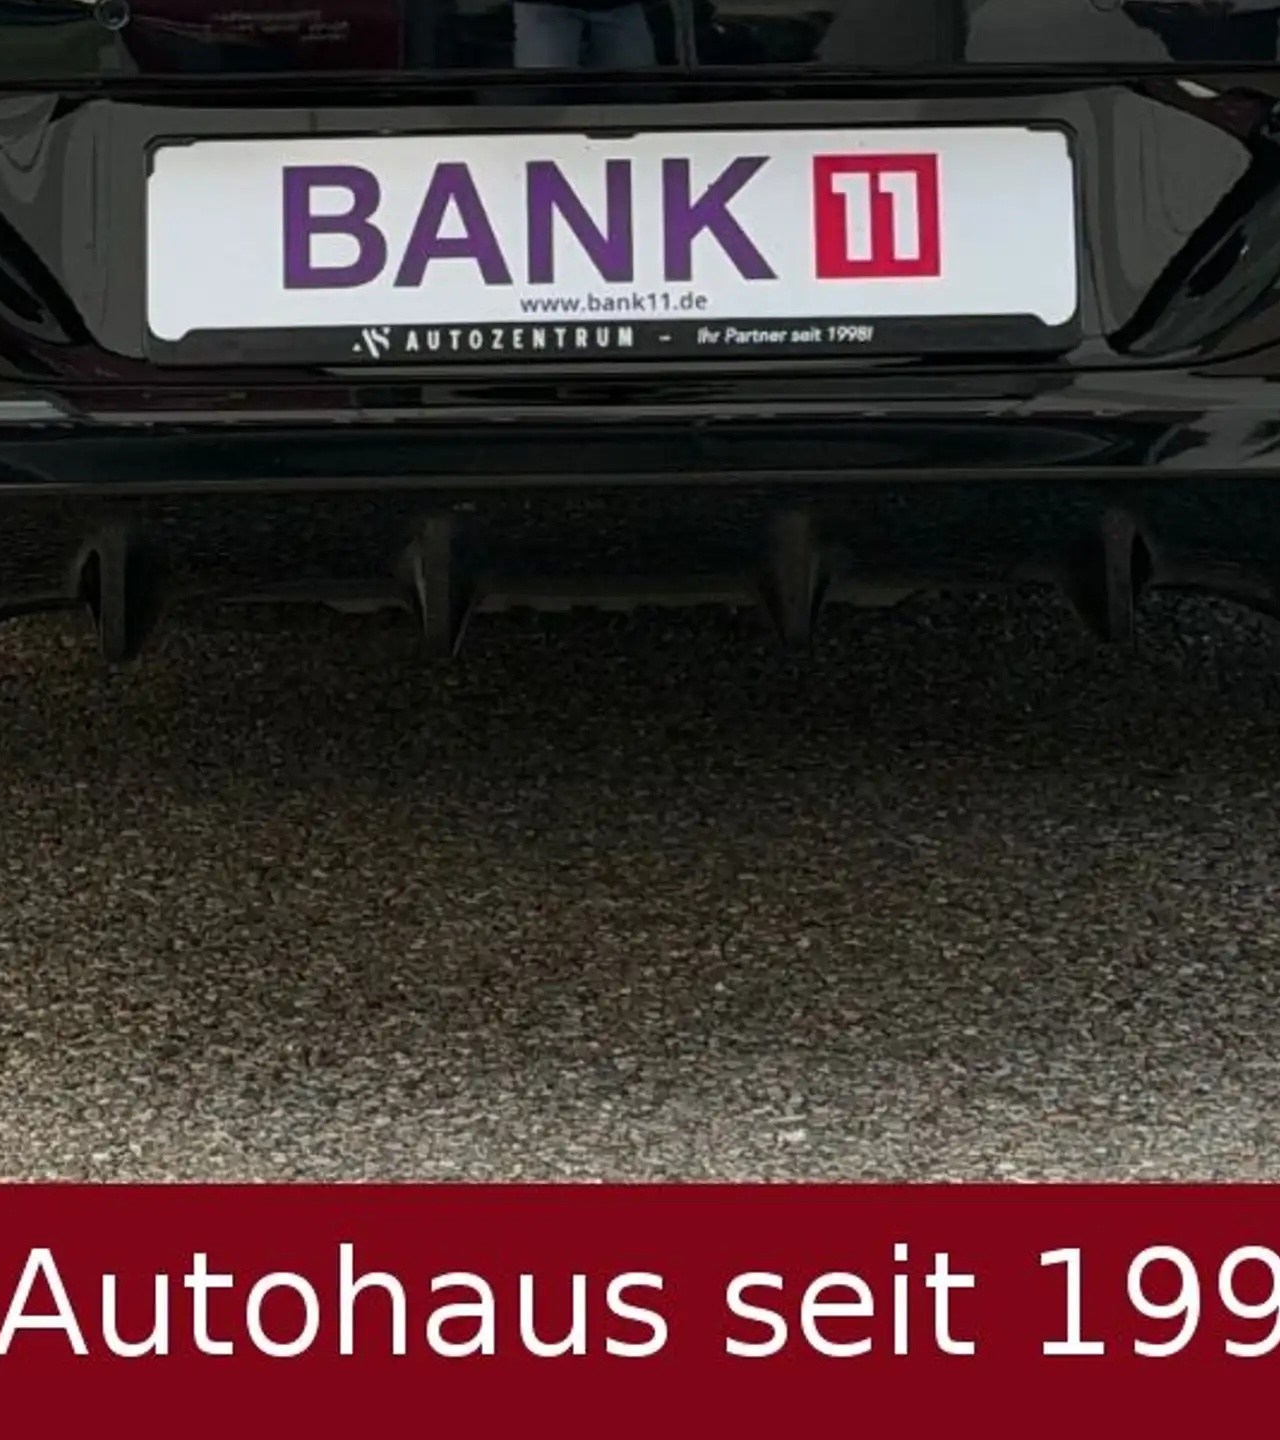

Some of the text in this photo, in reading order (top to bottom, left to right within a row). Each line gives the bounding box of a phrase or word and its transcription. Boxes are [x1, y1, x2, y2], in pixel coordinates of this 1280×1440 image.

[280, 154, 920, 291] BANK 11
[520, 292, 709, 315] www.bank11.de
[405, 326, 634, 351] AUTOZENTRUM
[697, 326, 720, 345] Ihr
[723, 326, 788, 344] Partner
[790, 326, 822, 343] seit
